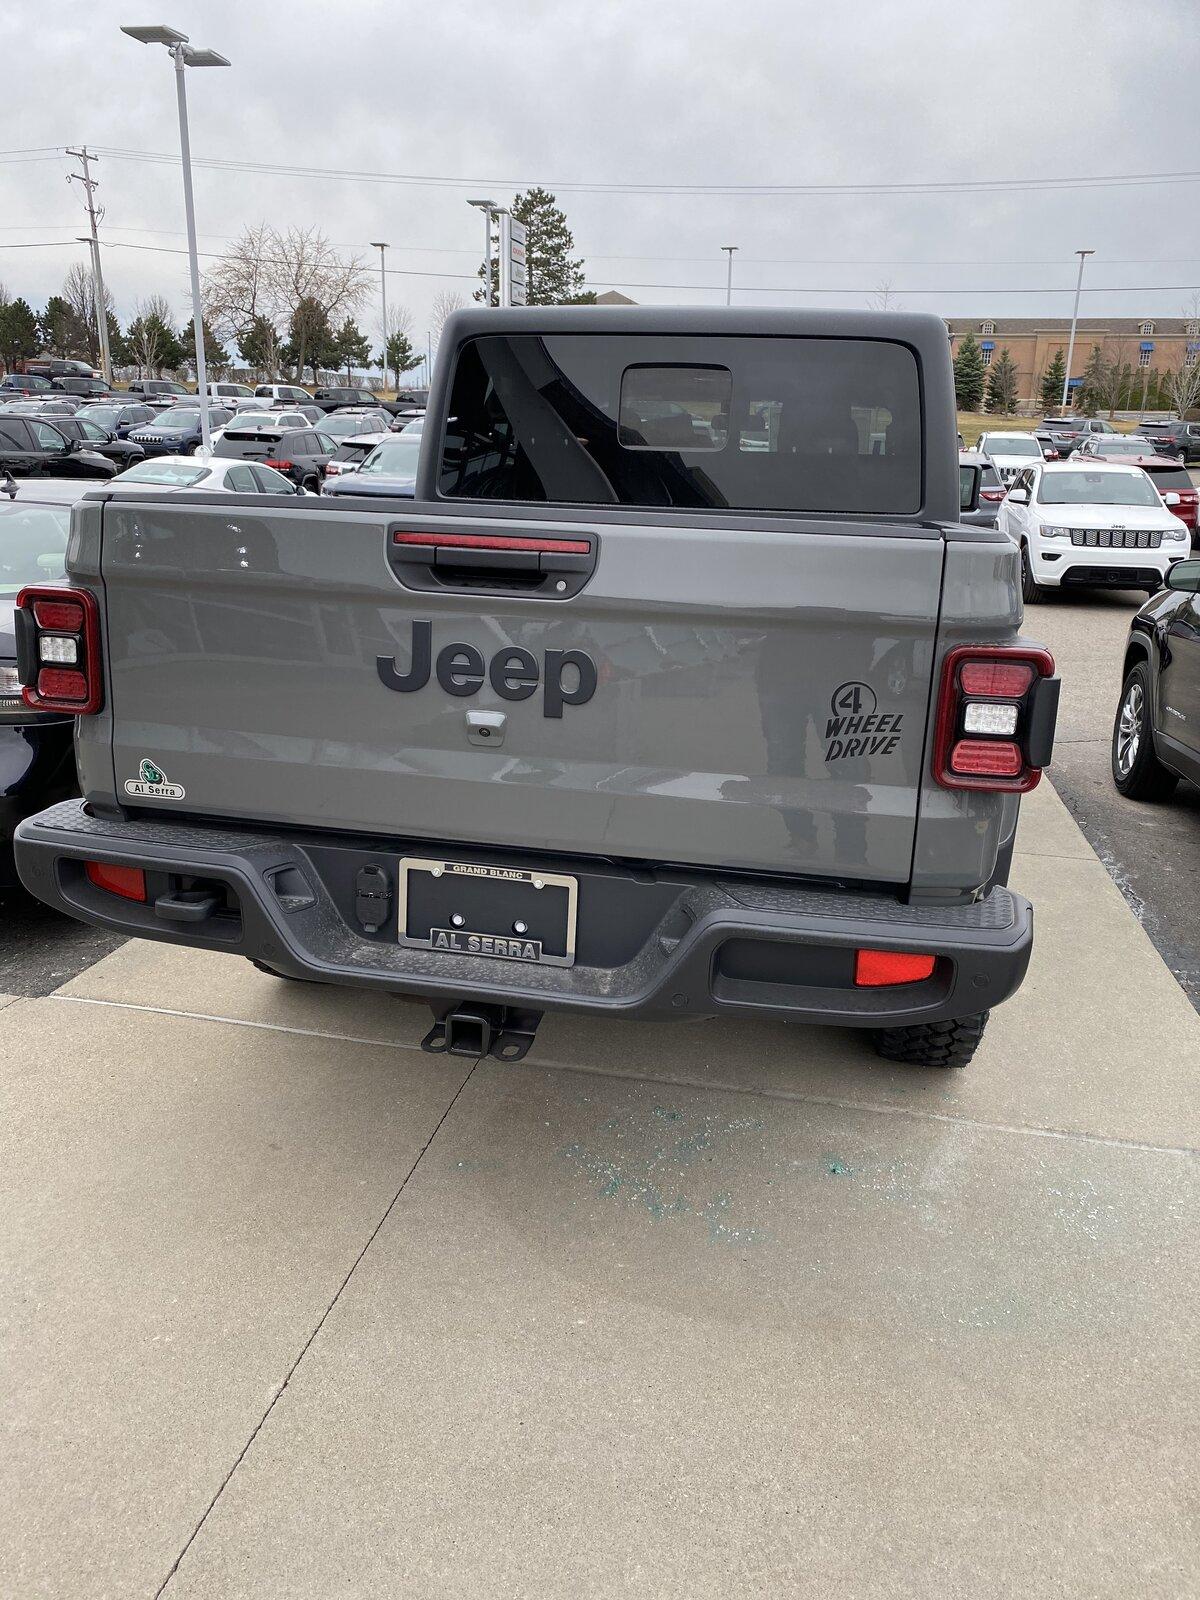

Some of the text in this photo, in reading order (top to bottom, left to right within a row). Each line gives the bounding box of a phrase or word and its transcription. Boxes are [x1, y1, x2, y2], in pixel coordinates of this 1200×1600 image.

[376, 619, 597, 718] Jeep
[838, 687, 862, 714] 4
[825, 714, 904, 739] WHEEL
[825, 736, 901, 762] DRIVE
[134, 784, 176, 796] Al Serra
[453, 865, 523, 879] GRAND BLANC
[435, 932, 537, 960] AL SERRA
